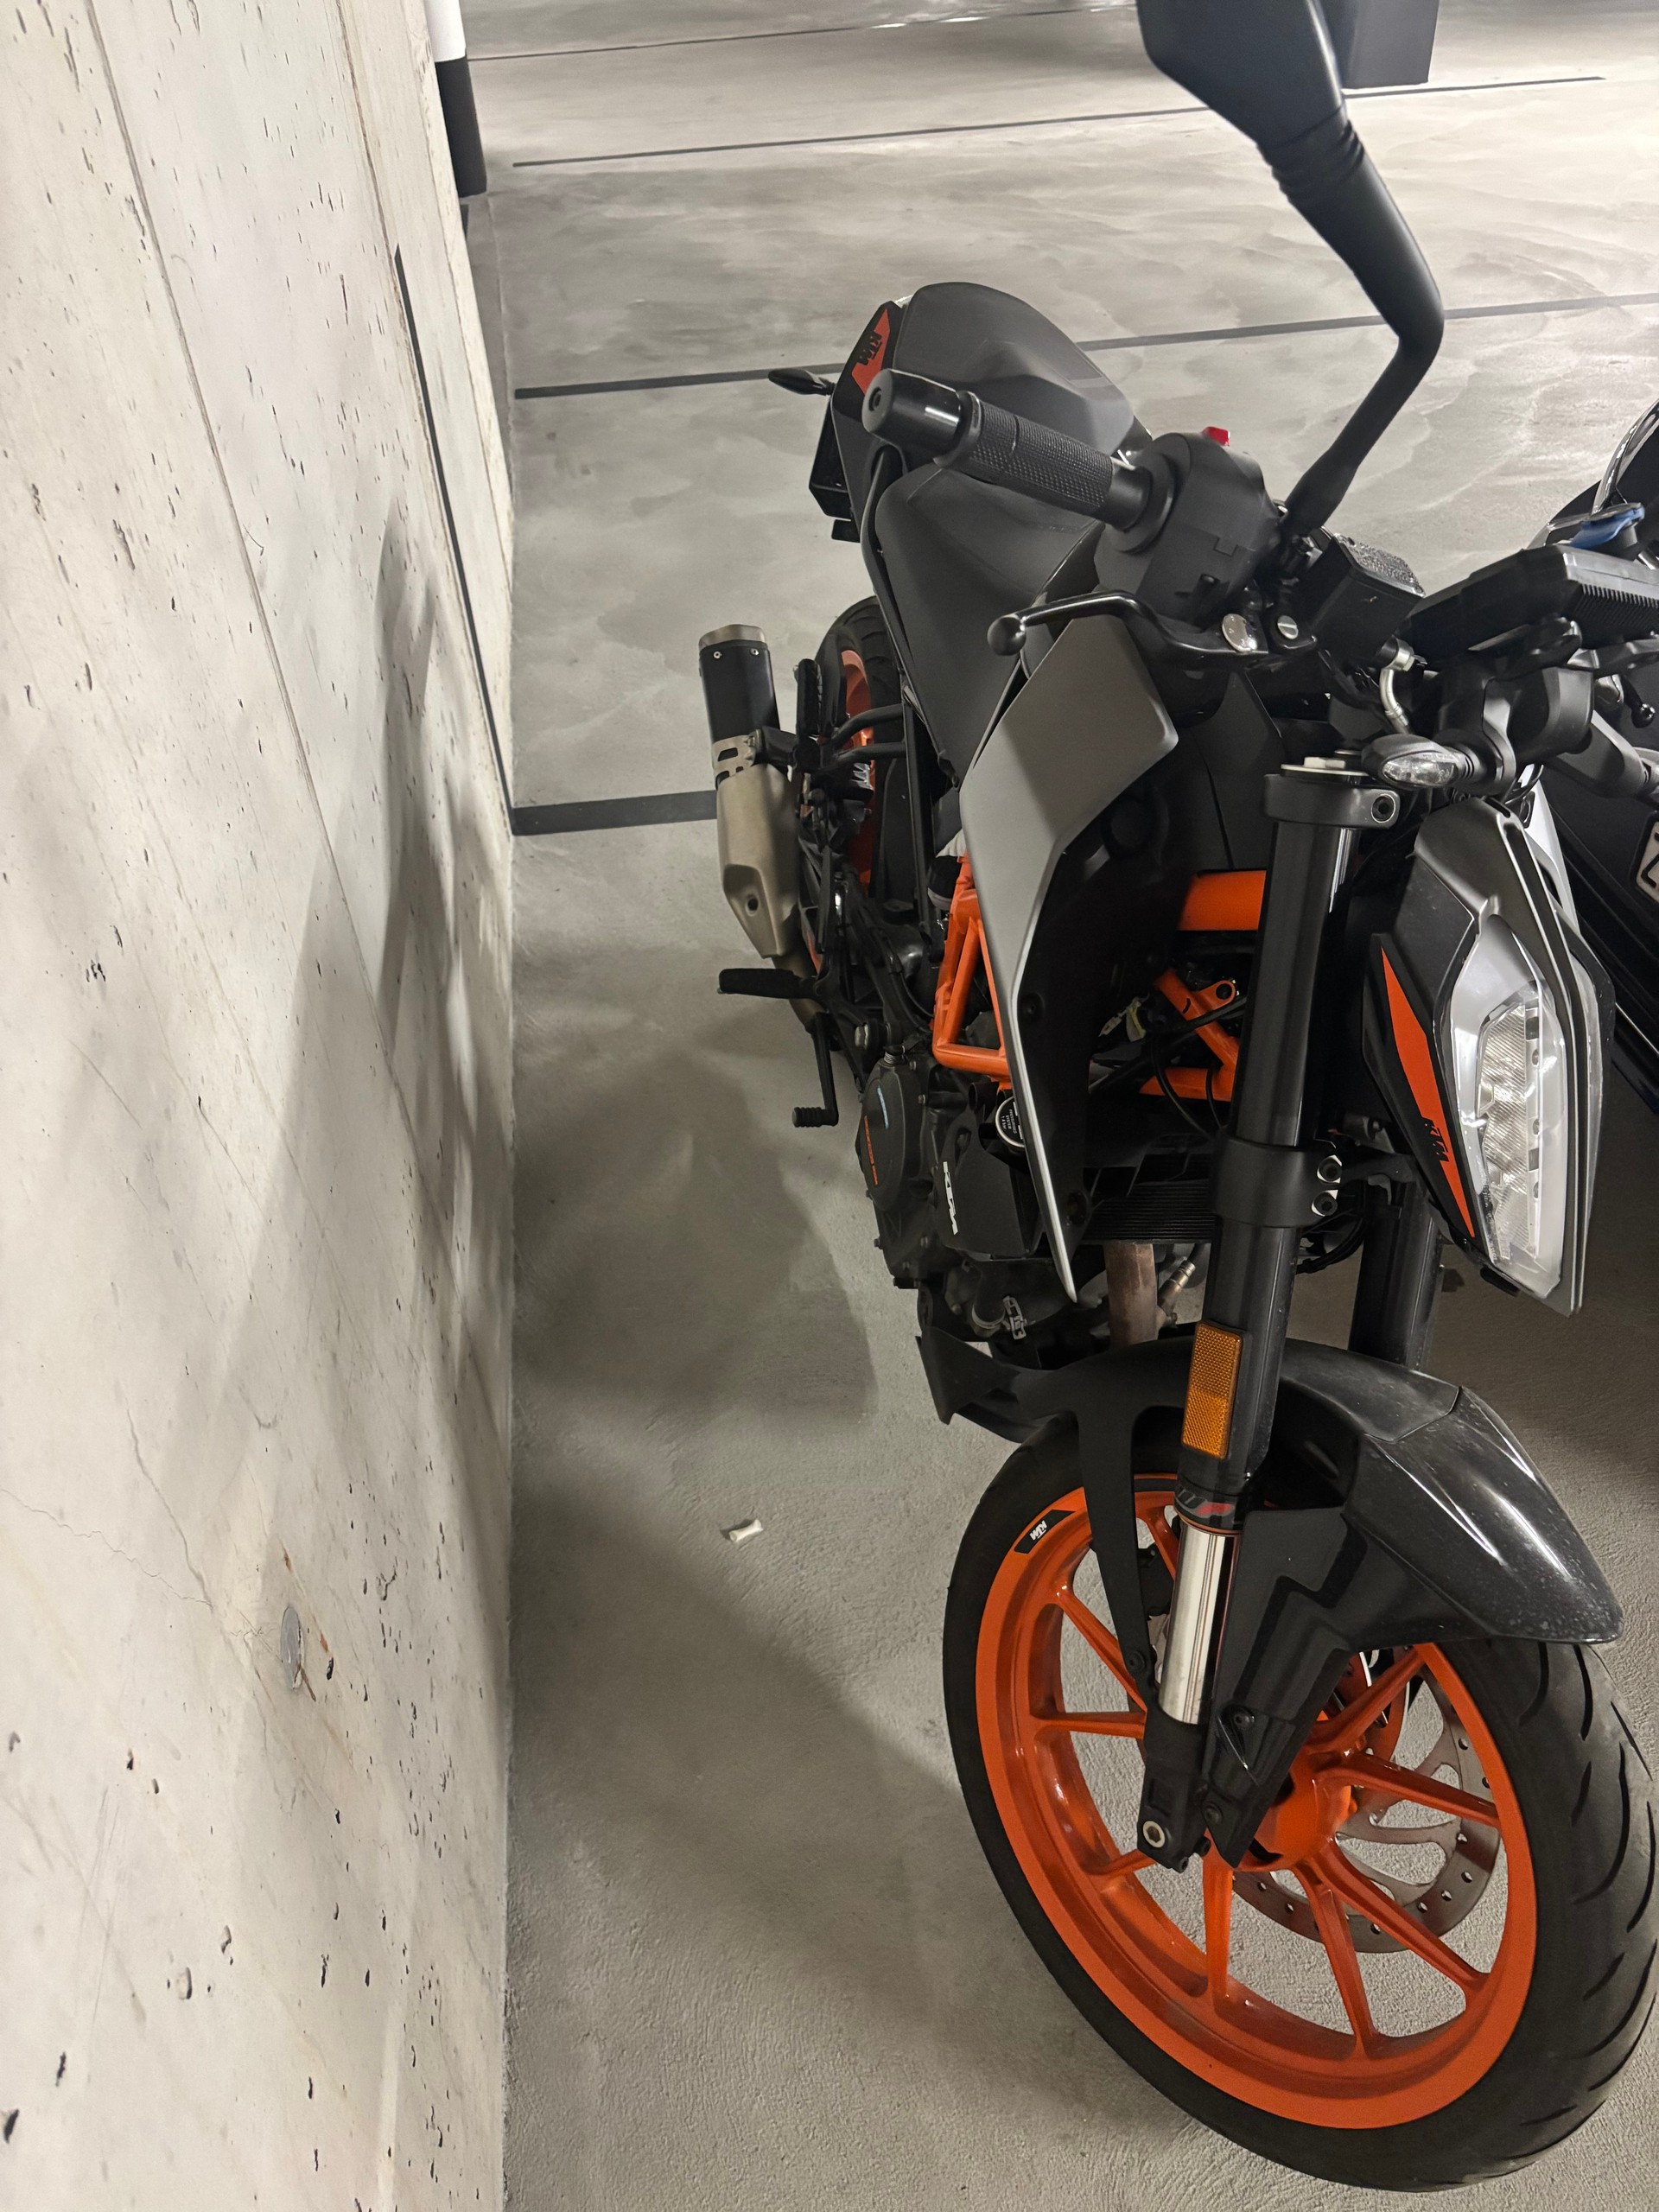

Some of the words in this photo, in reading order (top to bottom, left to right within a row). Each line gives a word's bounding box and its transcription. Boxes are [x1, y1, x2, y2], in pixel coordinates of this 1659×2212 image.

[856, 331, 883, 366] KTM
[1421, 1116, 1450, 1162] KTM
[943, 1161, 958, 1236] KTM
[1029, 1520, 1047, 1541] KTM
